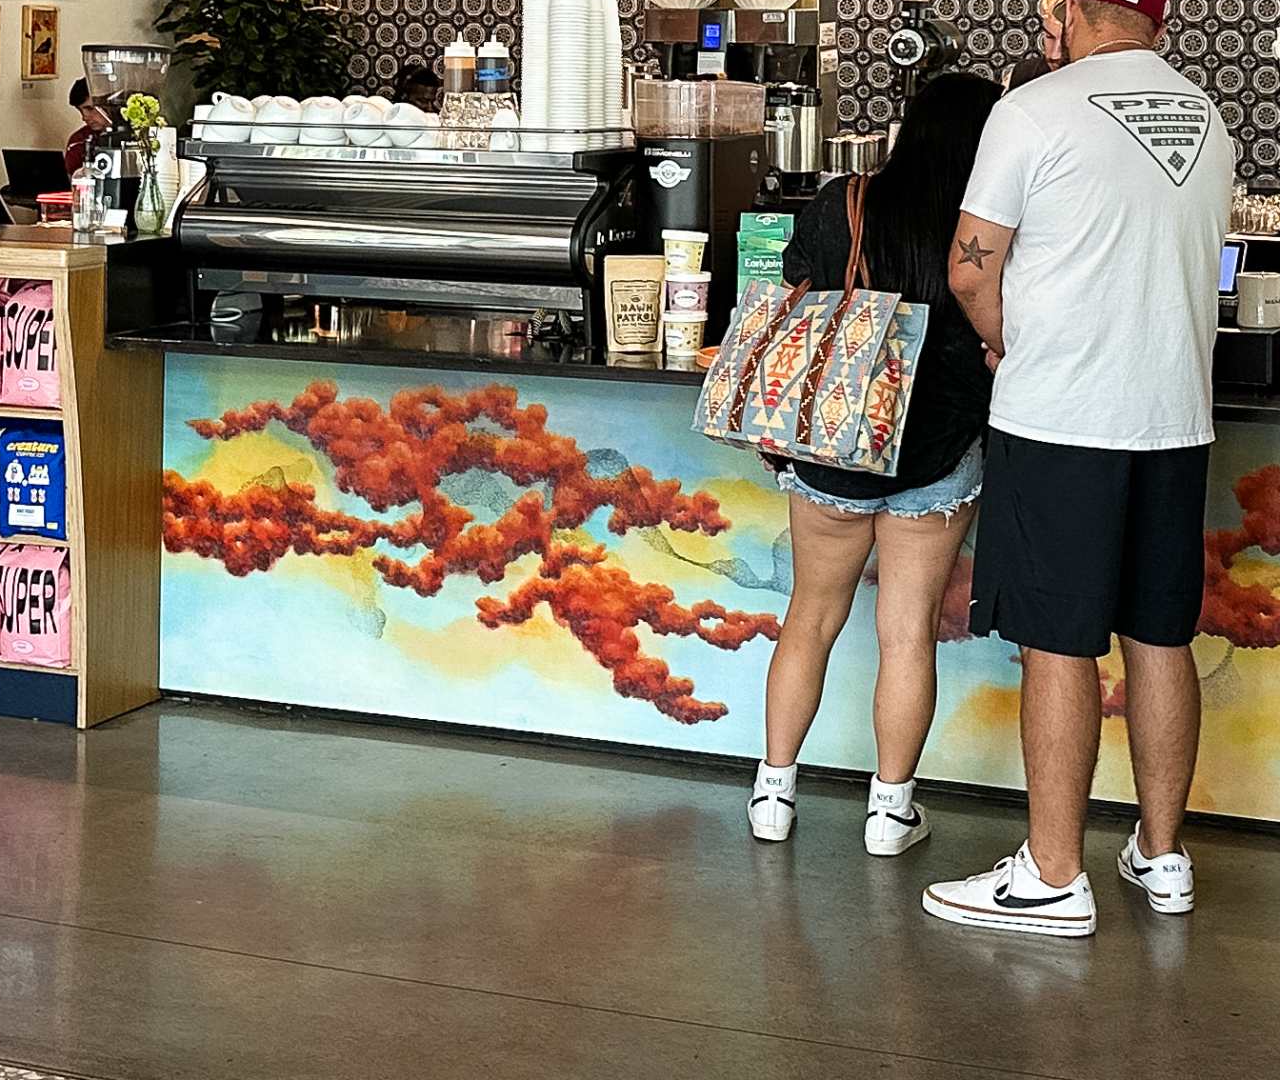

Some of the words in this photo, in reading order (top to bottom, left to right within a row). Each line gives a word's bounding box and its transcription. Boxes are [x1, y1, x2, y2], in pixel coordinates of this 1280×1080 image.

[1111, 99, 1206, 110] PFG
[6, 441, 59, 454] creature
[765, 777, 783, 787] NIKE
[876, 793, 895, 804] NIKE
[1162, 863, 1184, 874] NIKE
